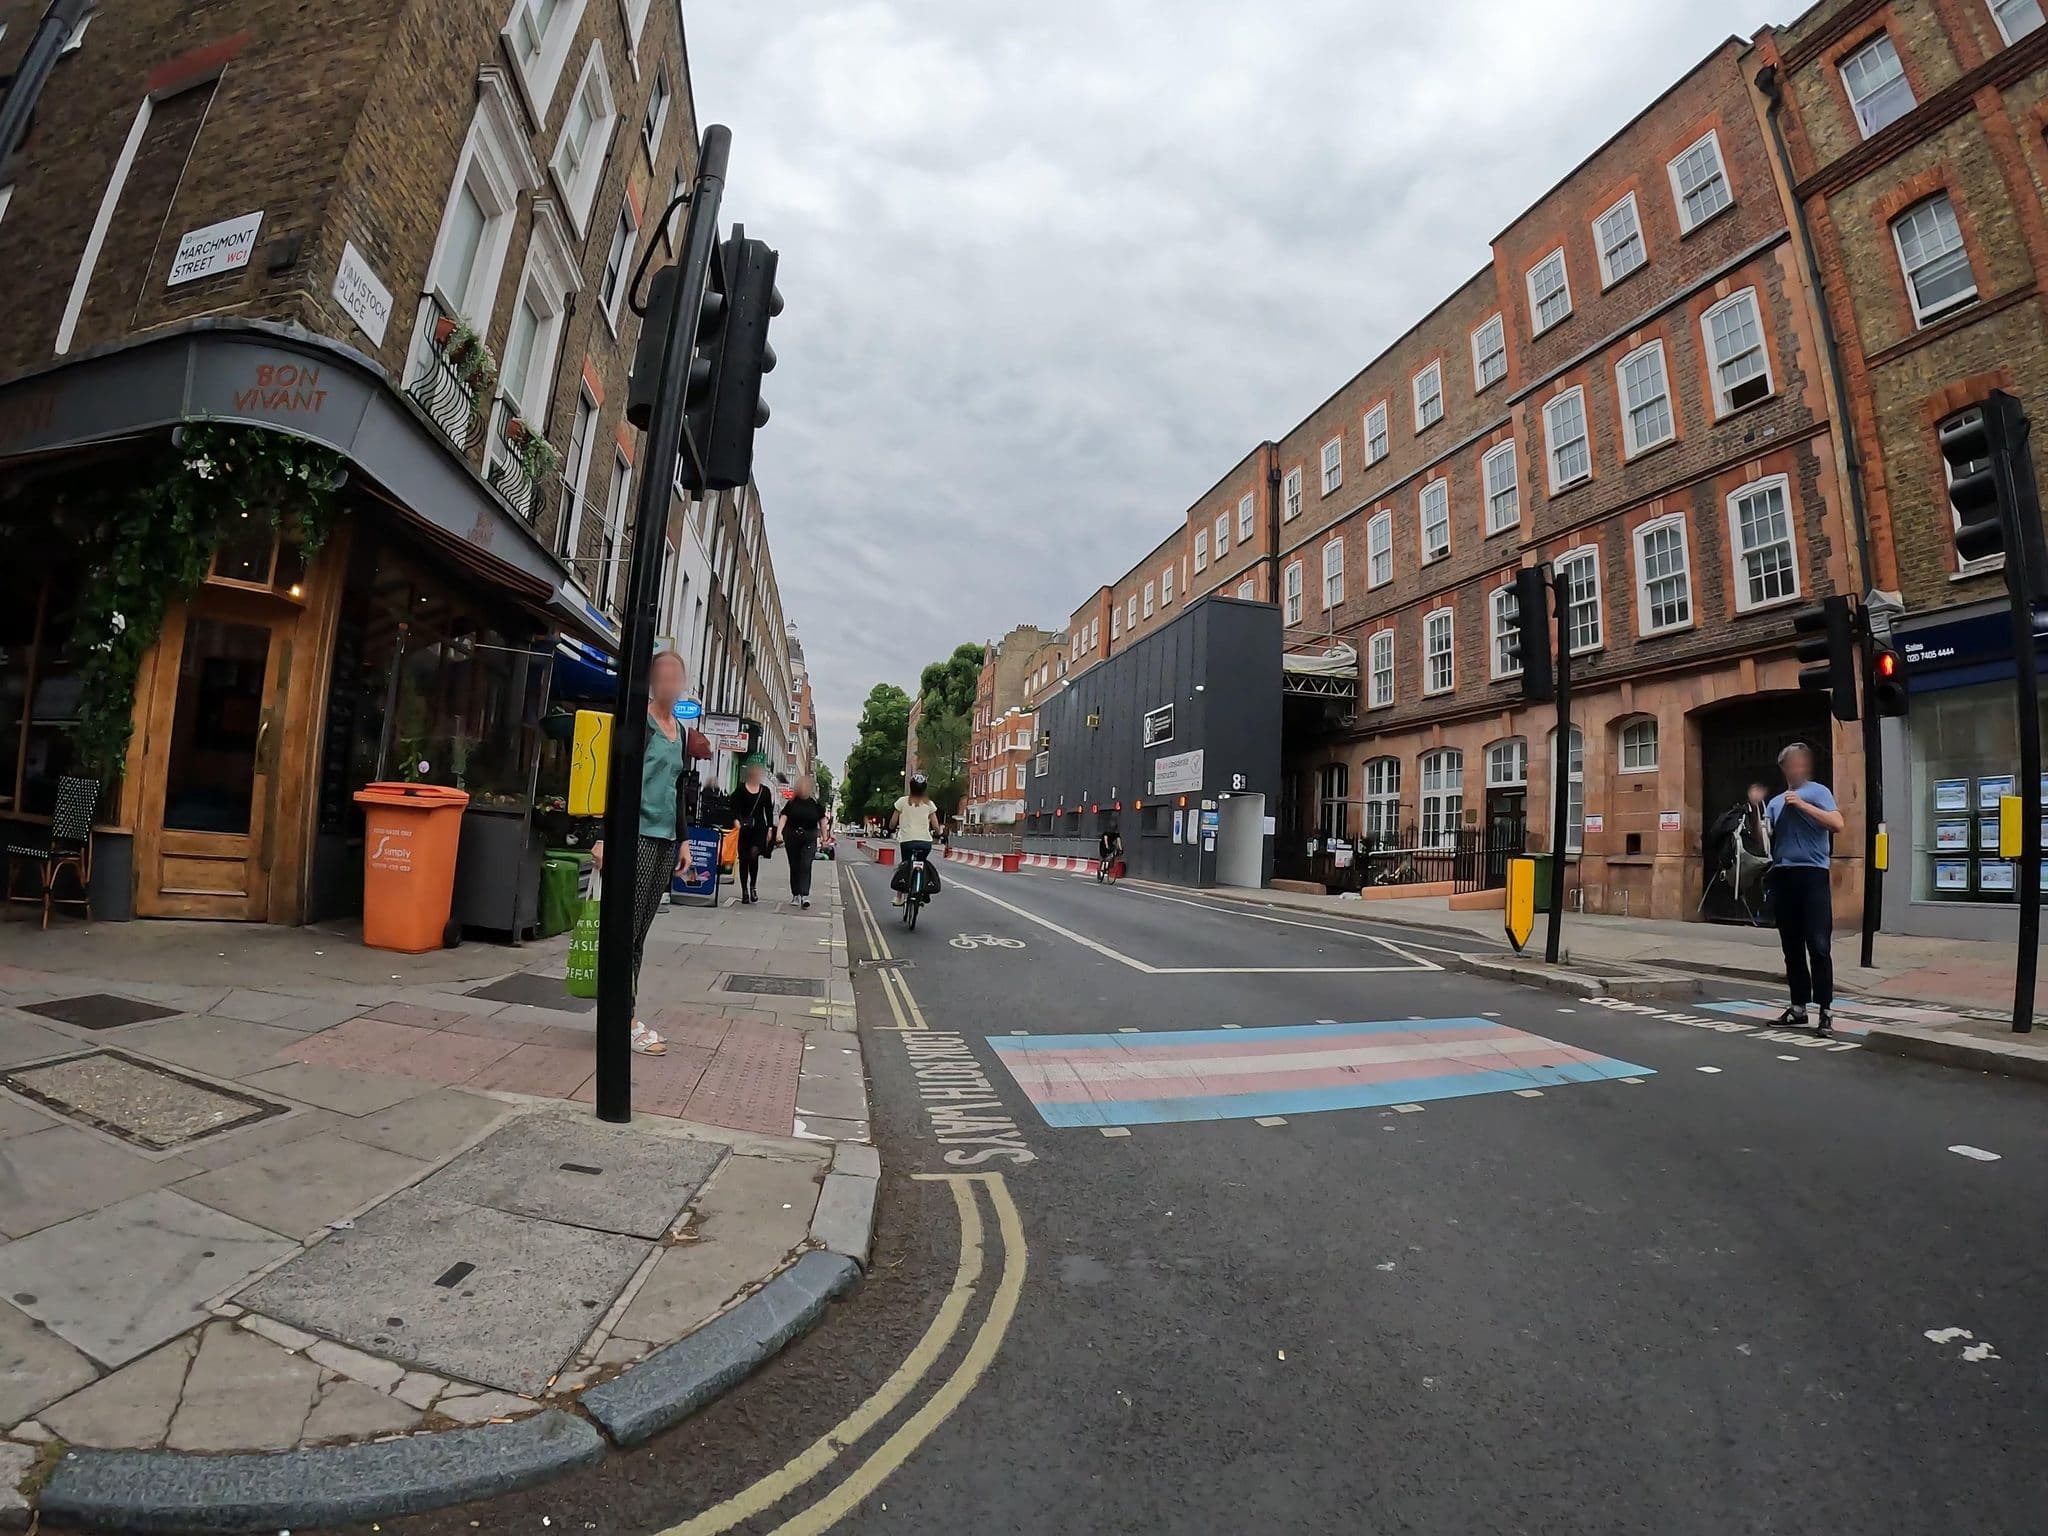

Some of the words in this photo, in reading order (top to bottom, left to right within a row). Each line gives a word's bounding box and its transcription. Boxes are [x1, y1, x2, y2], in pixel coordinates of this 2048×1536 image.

[178, 229, 254, 261] MARCHMONT
[173, 255, 215, 278] STREET
[339, 280, 366, 320] PLACE
[342, 260, 387, 323] TAVISTOCK
[256, 364, 320, 387] BON
[233, 389, 328, 412] VIVANT
[900, 1031, 974, 1060] LOOK
[910, 1061, 998, 1099] BOTH
[924, 1101, 1039, 1166] WAYS
